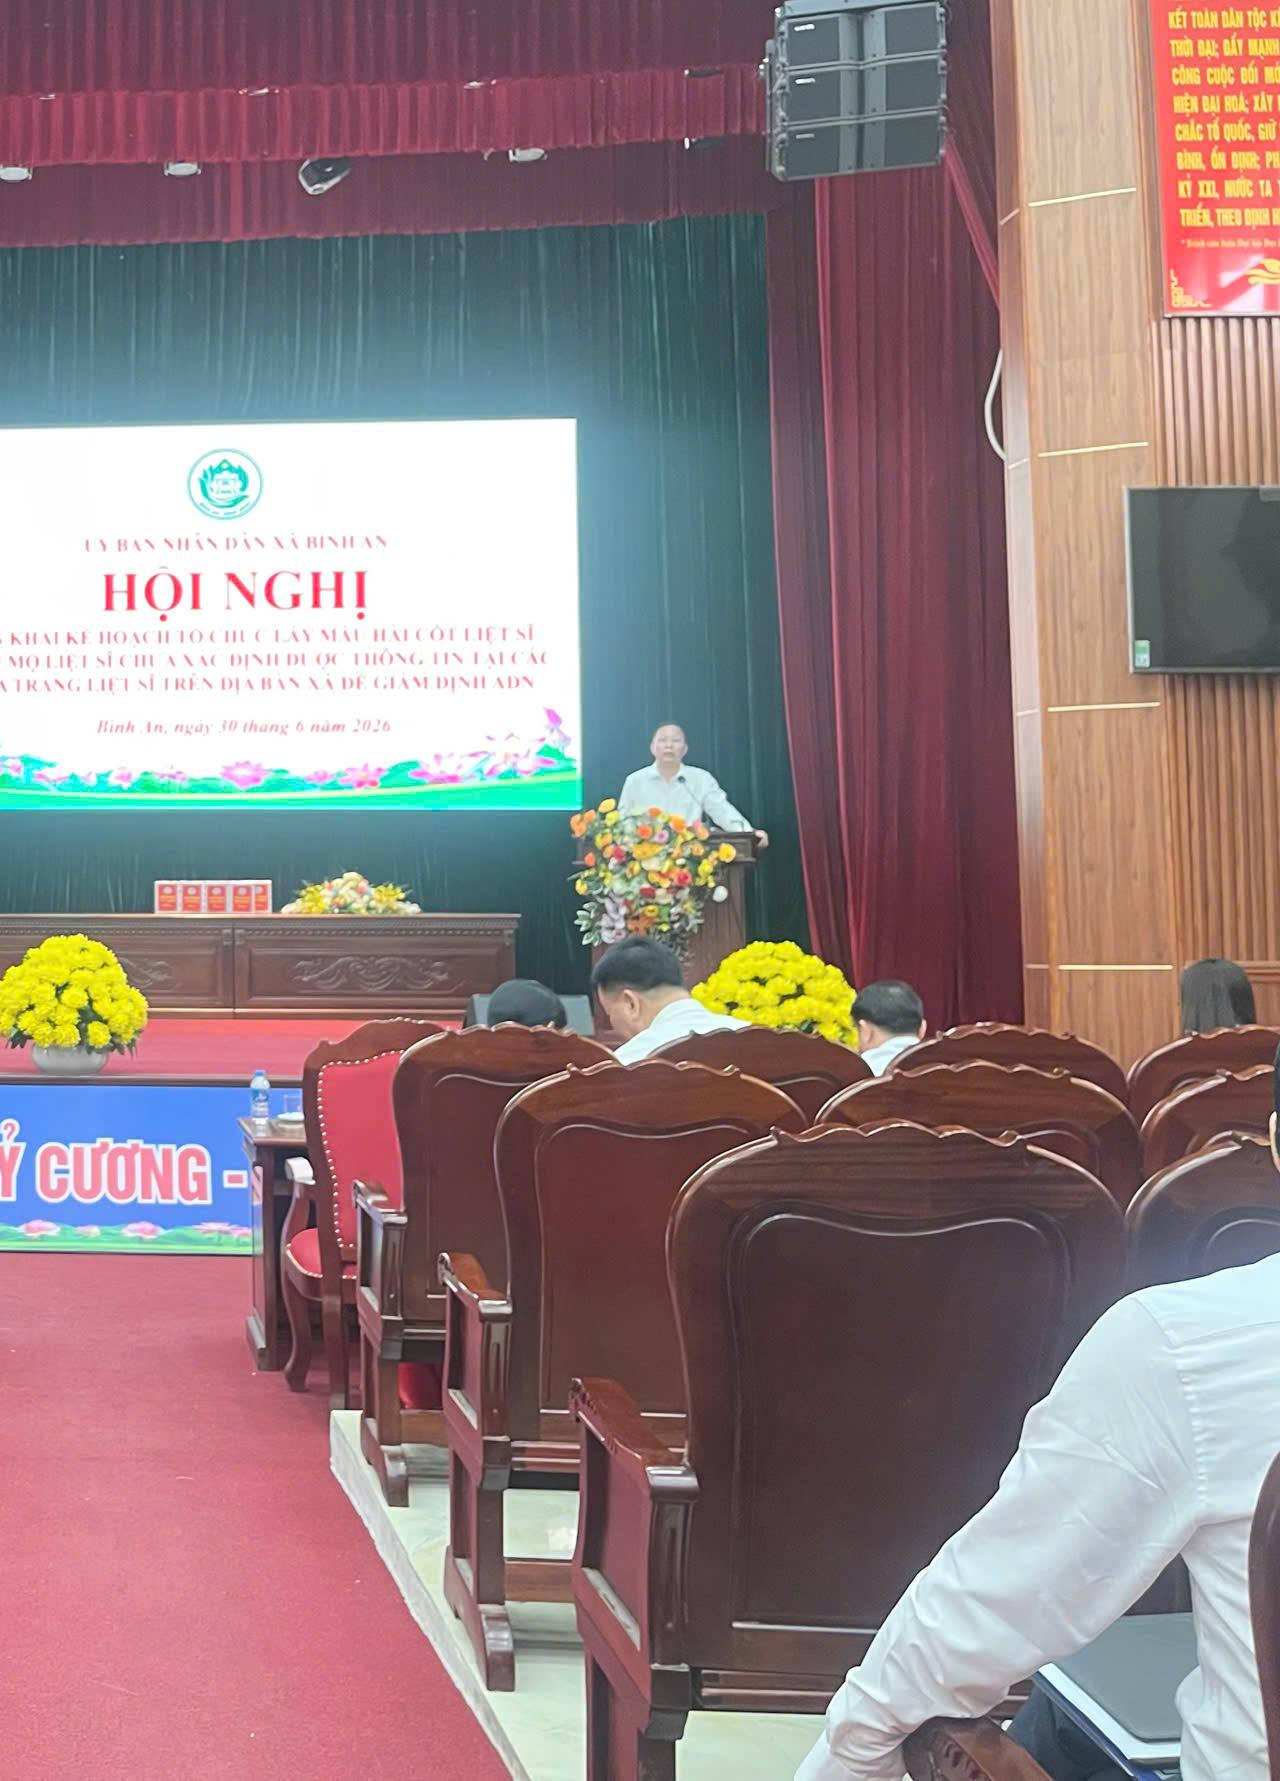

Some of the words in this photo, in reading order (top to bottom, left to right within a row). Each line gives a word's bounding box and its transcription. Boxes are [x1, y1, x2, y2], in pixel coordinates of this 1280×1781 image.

[103, 566, 202, 622] HỘI
[224, 570, 368, 620] NGHỊ
[493, 676, 535, 689] ADN
[35, 1137, 213, 1205] CƯƠNG
